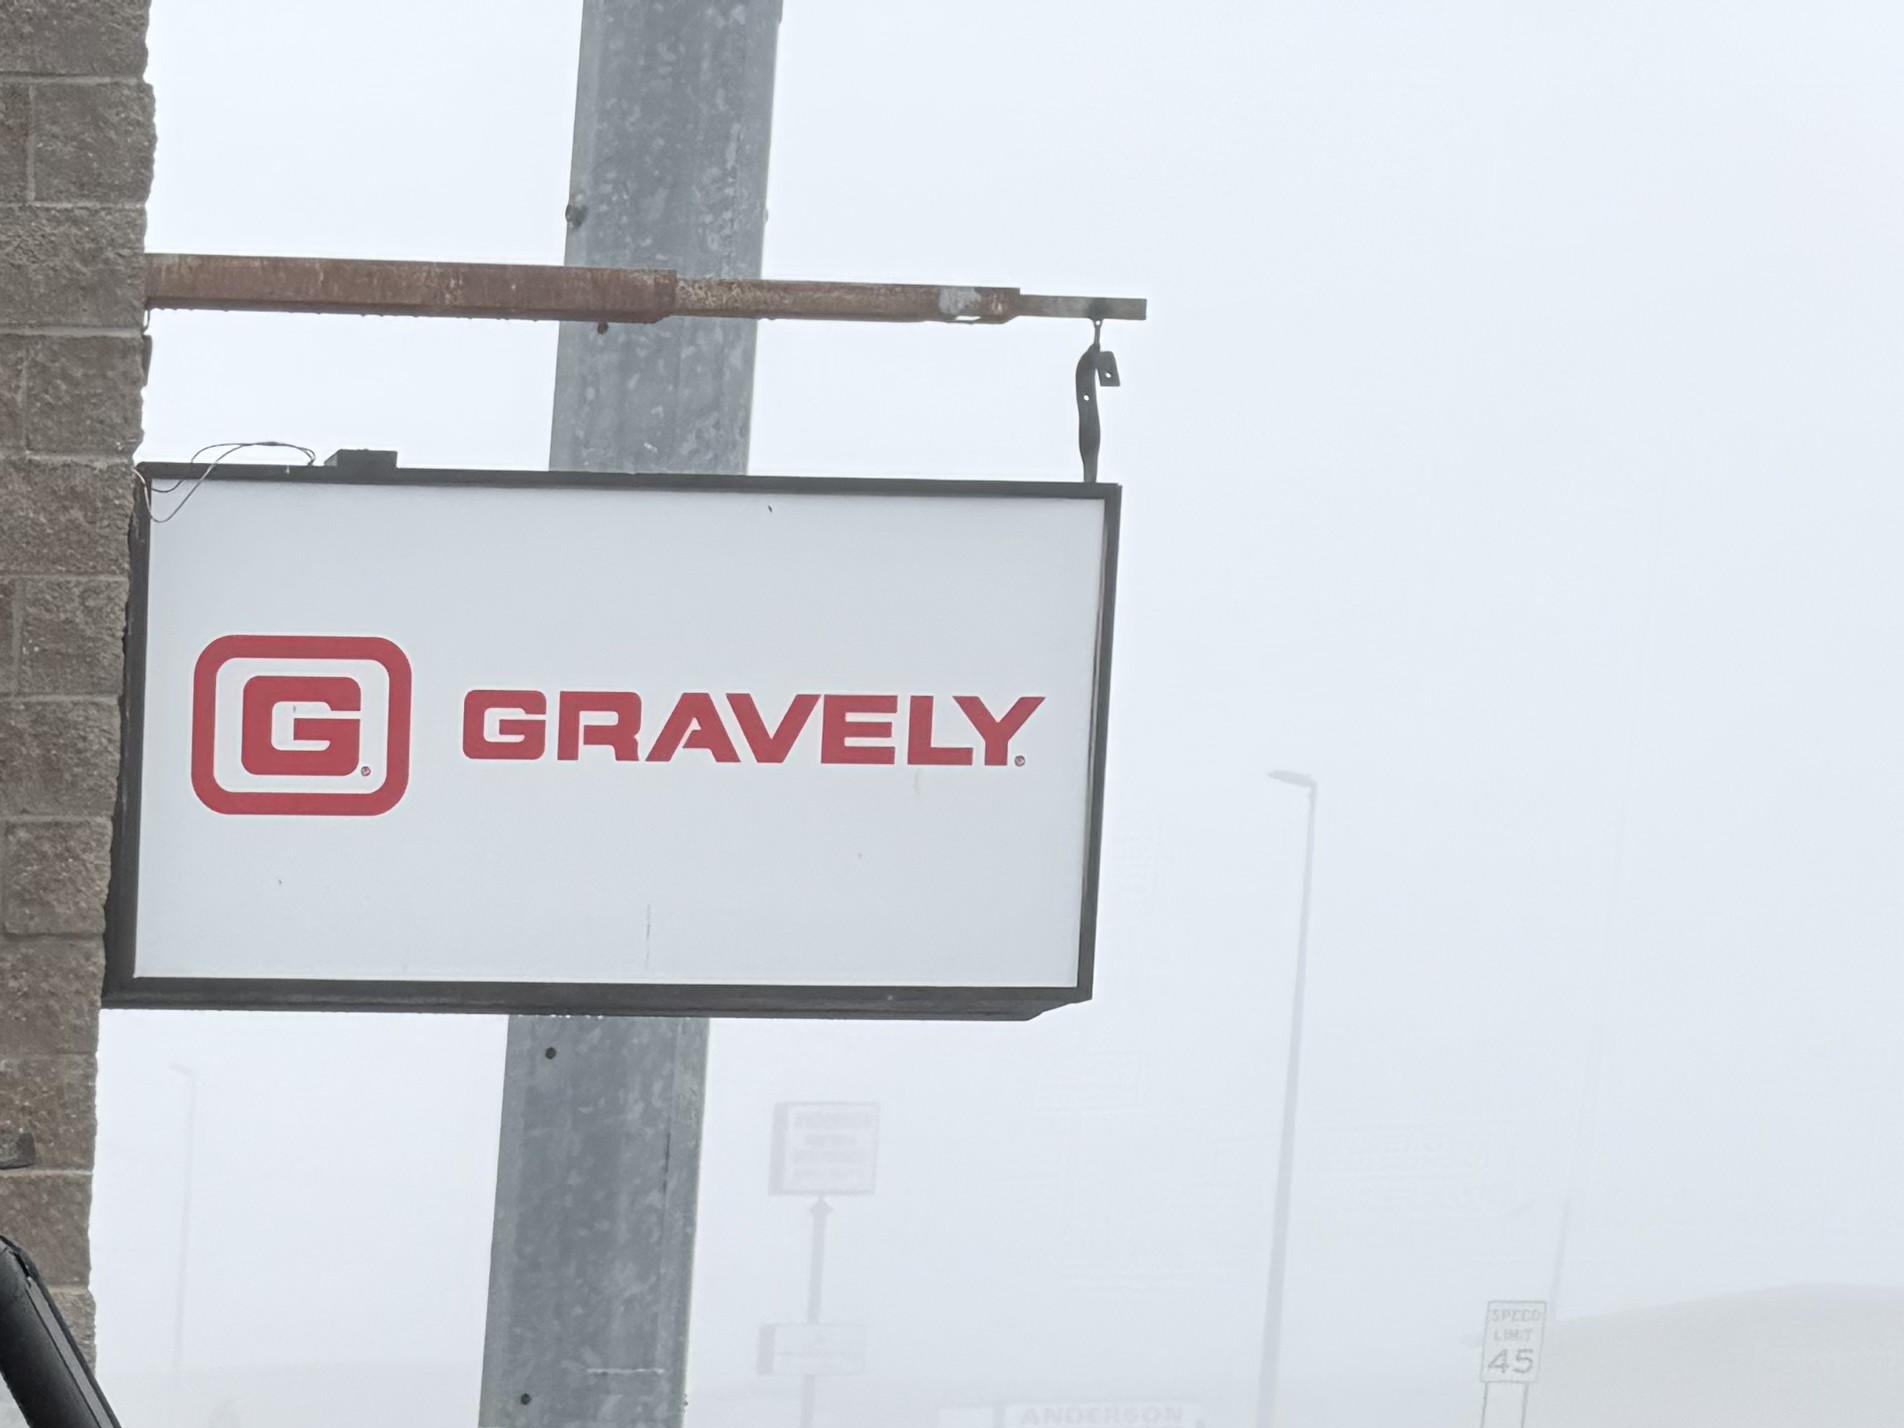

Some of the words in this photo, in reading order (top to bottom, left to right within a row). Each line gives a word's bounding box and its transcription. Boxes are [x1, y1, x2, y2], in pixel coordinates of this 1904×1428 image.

[462, 689, 1047, 766] GRAVELY
[1490, 1308, 1542, 1322] SPEED
[1494, 1328, 1534, 1342] LIMIT
[1487, 1348, 1534, 1374] 45
